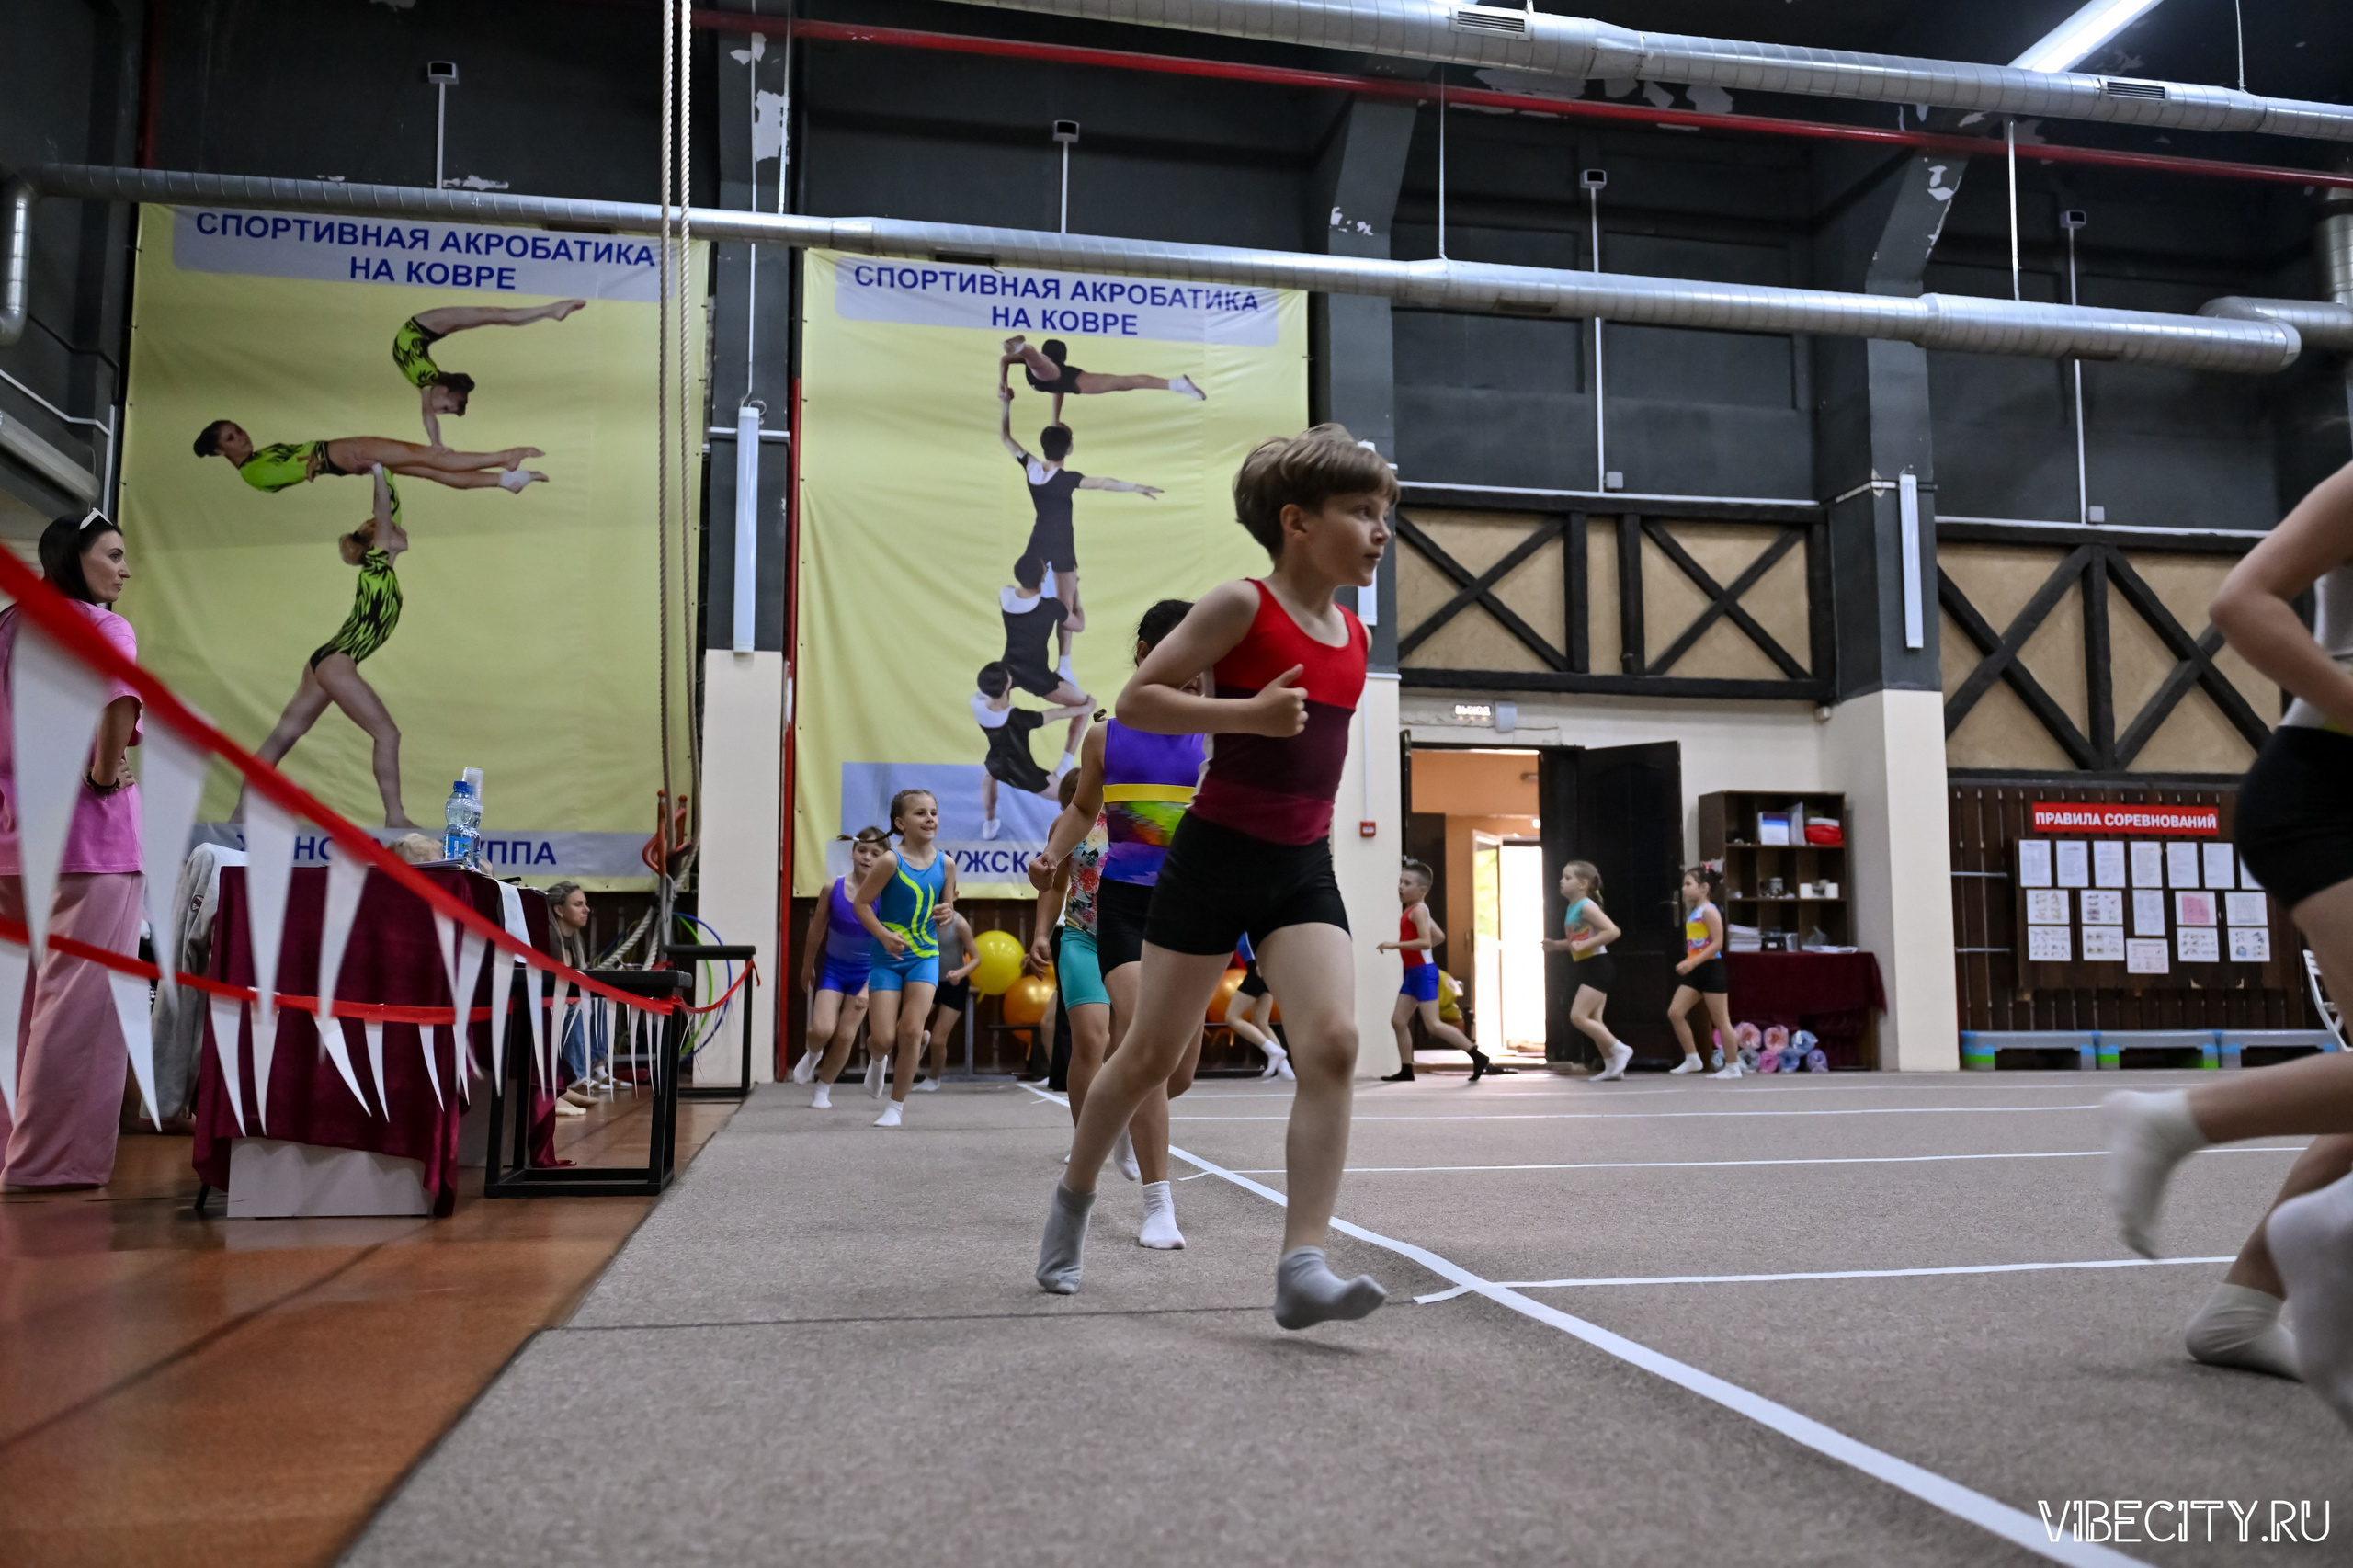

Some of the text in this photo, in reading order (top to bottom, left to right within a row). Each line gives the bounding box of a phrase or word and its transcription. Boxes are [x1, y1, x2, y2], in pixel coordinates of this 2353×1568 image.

[196, 212, 656, 267] СПОРТИВНАЯ АКРОБАТИКА
[349, 256, 517, 290] НА КОВРЕ
[854, 265, 1259, 312] СПОРТИВНАЯ АКРОБАТИКА
[991, 305, 1138, 335] НА КОВРЕ
[2035, 812, 2218, 829] ПРАВИЛА СОРЕВНОВАНИЙ
